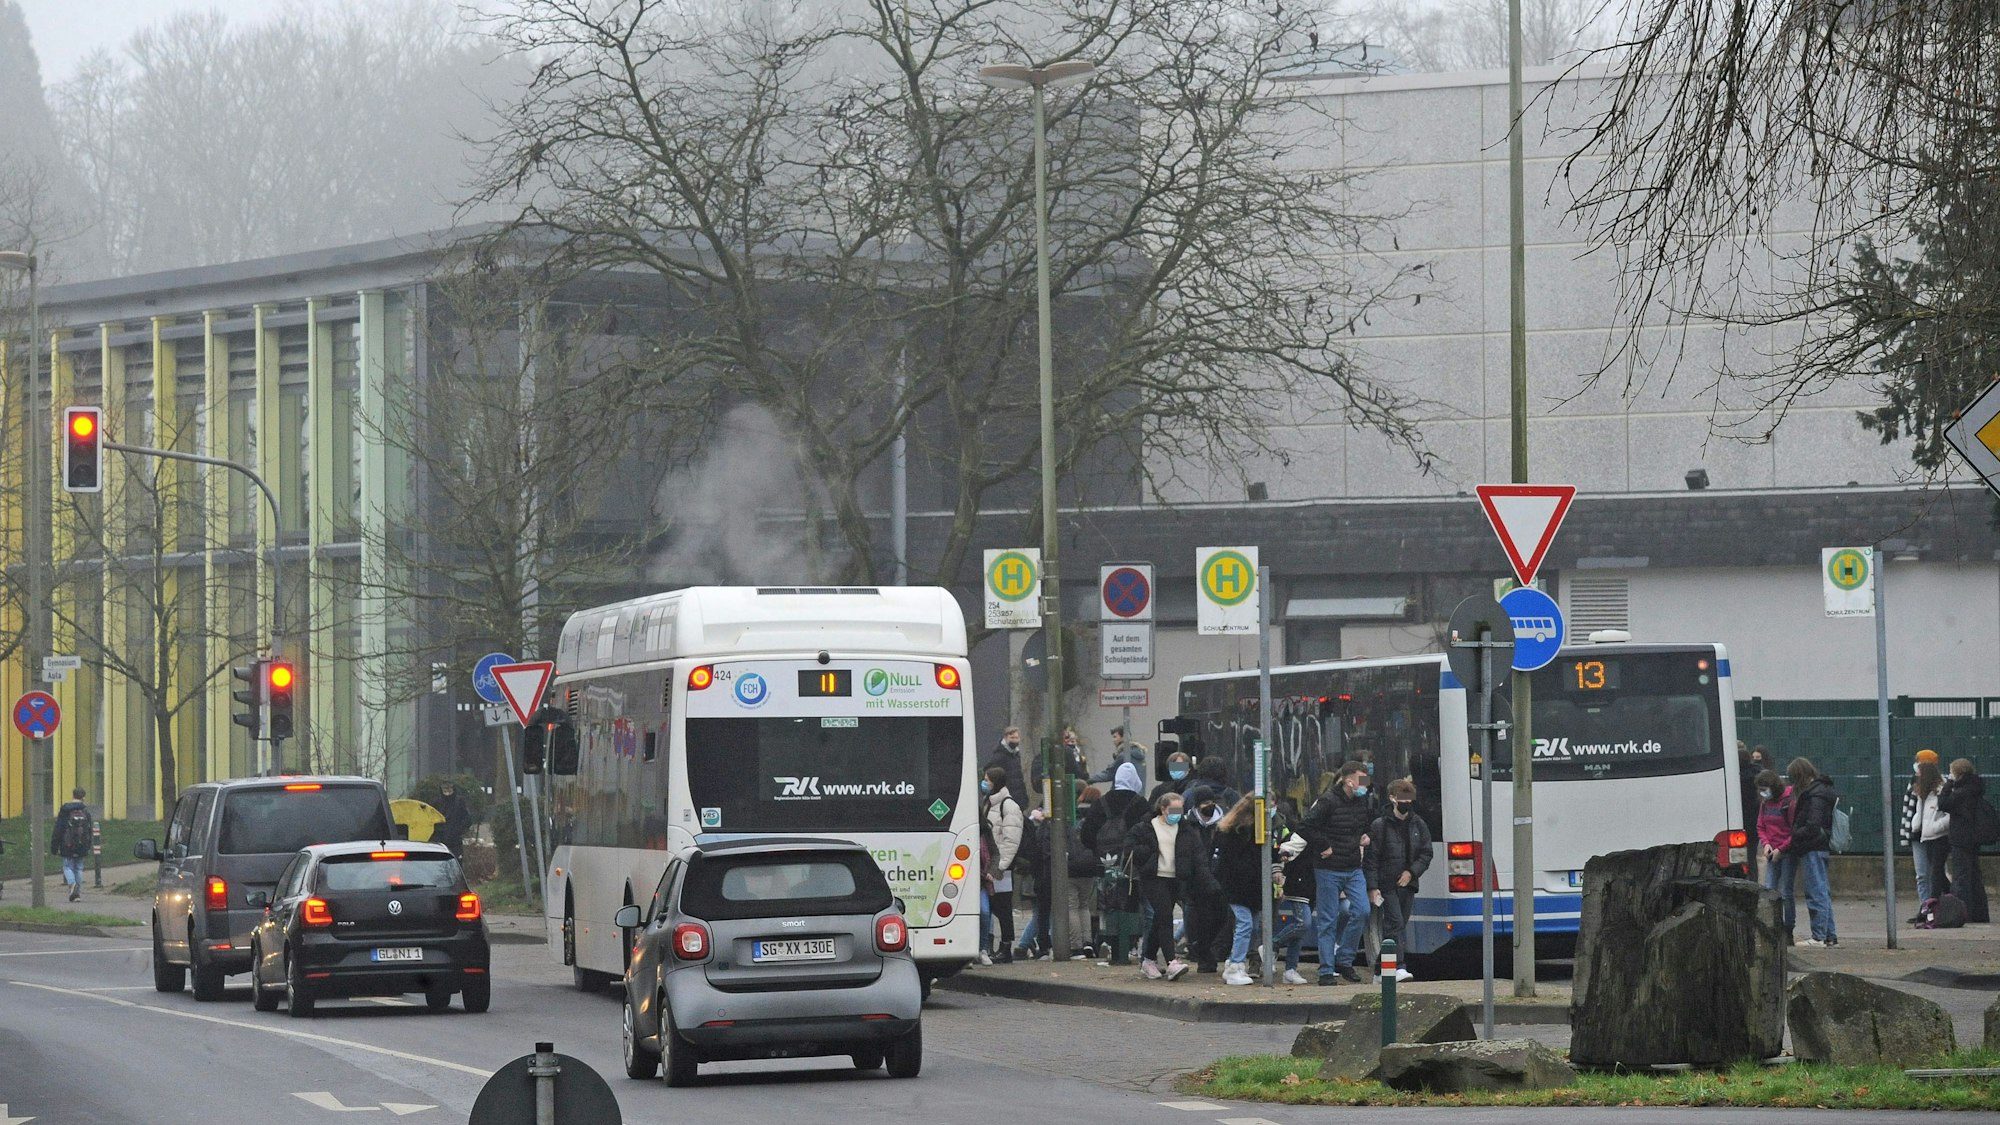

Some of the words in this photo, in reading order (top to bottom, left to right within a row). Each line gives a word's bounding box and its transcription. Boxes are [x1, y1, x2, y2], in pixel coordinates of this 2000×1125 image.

[1002, 564, 1023, 589] H
[1216, 564, 1239, 592] H
[1111, 646, 1142, 654] gesamten
[47, 659, 77, 668] Gymnasium
[1104, 656, 1148, 664] Schulgelände
[714, 670, 731, 680] 424
[890, 672, 922, 686] NULL
[1575, 661, 1605, 689] 13
[743, 684, 758, 694] FCH
[866, 698, 884, 708] mit
[887, 698, 950, 708] Wasserstoff
[1572, 740, 1662, 755] www.rvk.de
[823, 781, 915, 795] www.rvk.de
[869, 848, 897, 861] ren
[378, 949, 393, 959] GL
[399, 949, 412, 958] NI
[415, 949, 421, 958] 1
[762, 943, 777, 955] SG
[786, 942, 800, 955] XX
[804, 941, 833, 954] 130E
